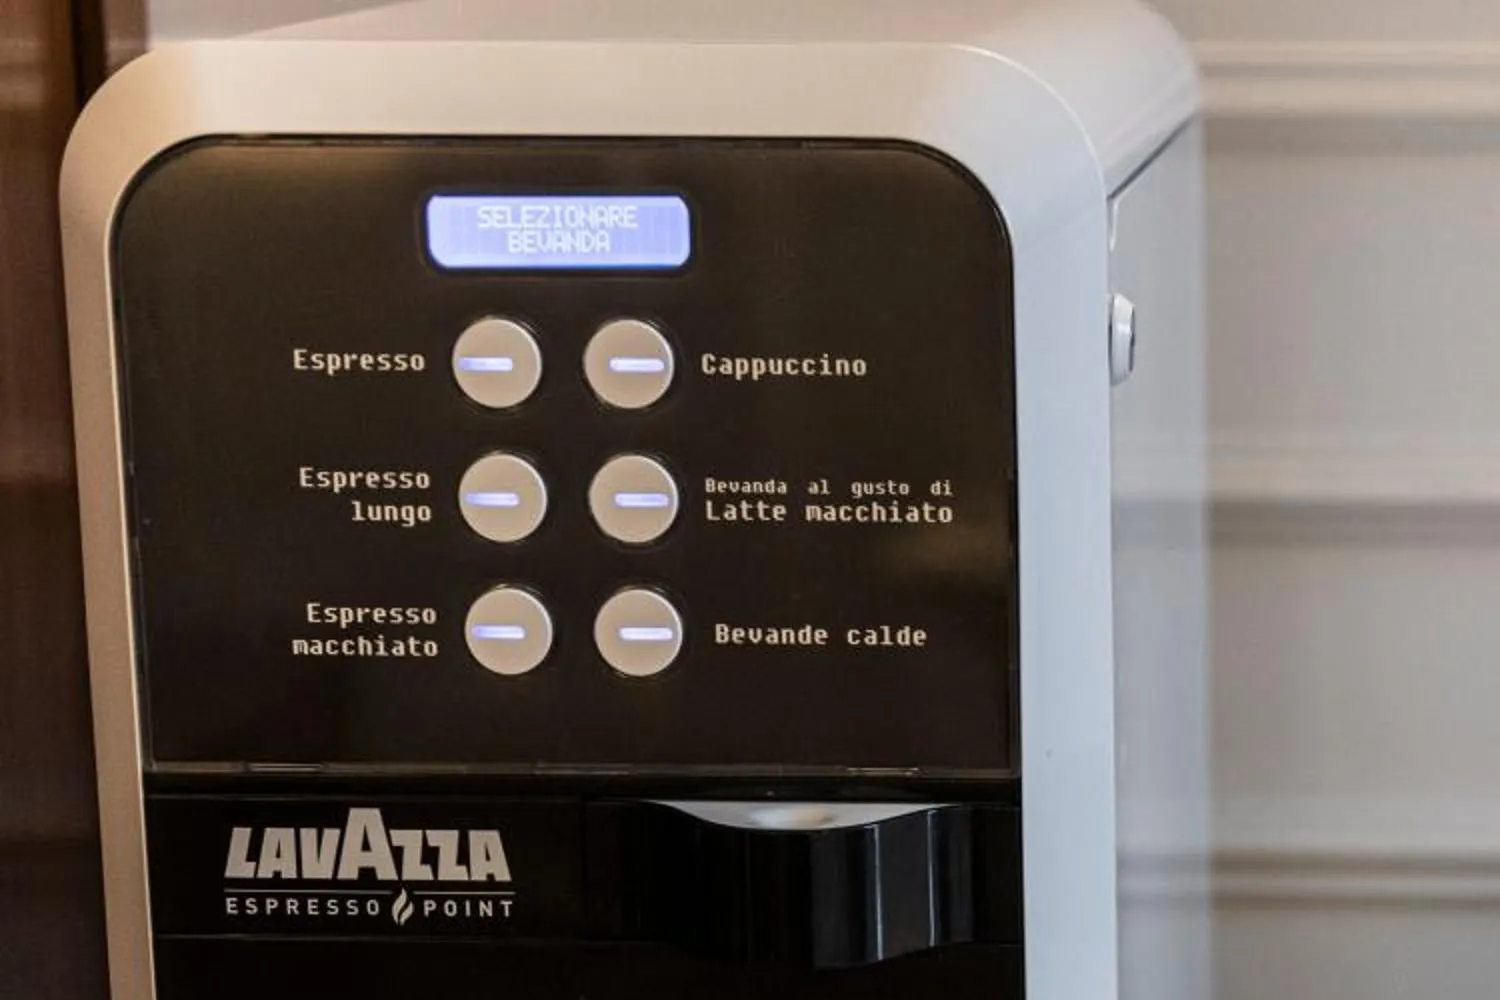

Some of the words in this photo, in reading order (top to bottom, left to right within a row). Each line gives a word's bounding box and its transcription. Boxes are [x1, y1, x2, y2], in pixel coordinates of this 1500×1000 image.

[477, 205, 639, 228] SELEZIONARE
[507, 230, 612, 253] BEVANDA
[292, 348, 426, 376] Espresso
[700, 353, 868, 381] Cappuccino
[299, 467, 431, 493] Espresso
[704, 477, 788, 495] Bevanda
[807, 478, 831, 496] al
[850, 479, 911, 500] gusto
[929, 478, 954, 497] di
[351, 500, 433, 527] lungo
[705, 498, 788, 522] Latte
[804, 499, 954, 524] macchiato
[306, 602, 438, 629] Espresso
[291, 634, 439, 658] macchiato
[714, 622, 830, 646] Bevande
[846, 624, 928, 647] calde
[223, 807, 512, 882] LAVAZZA
[225, 897, 381, 916] ESPRESSO
[423, 899, 513, 917] POINT
